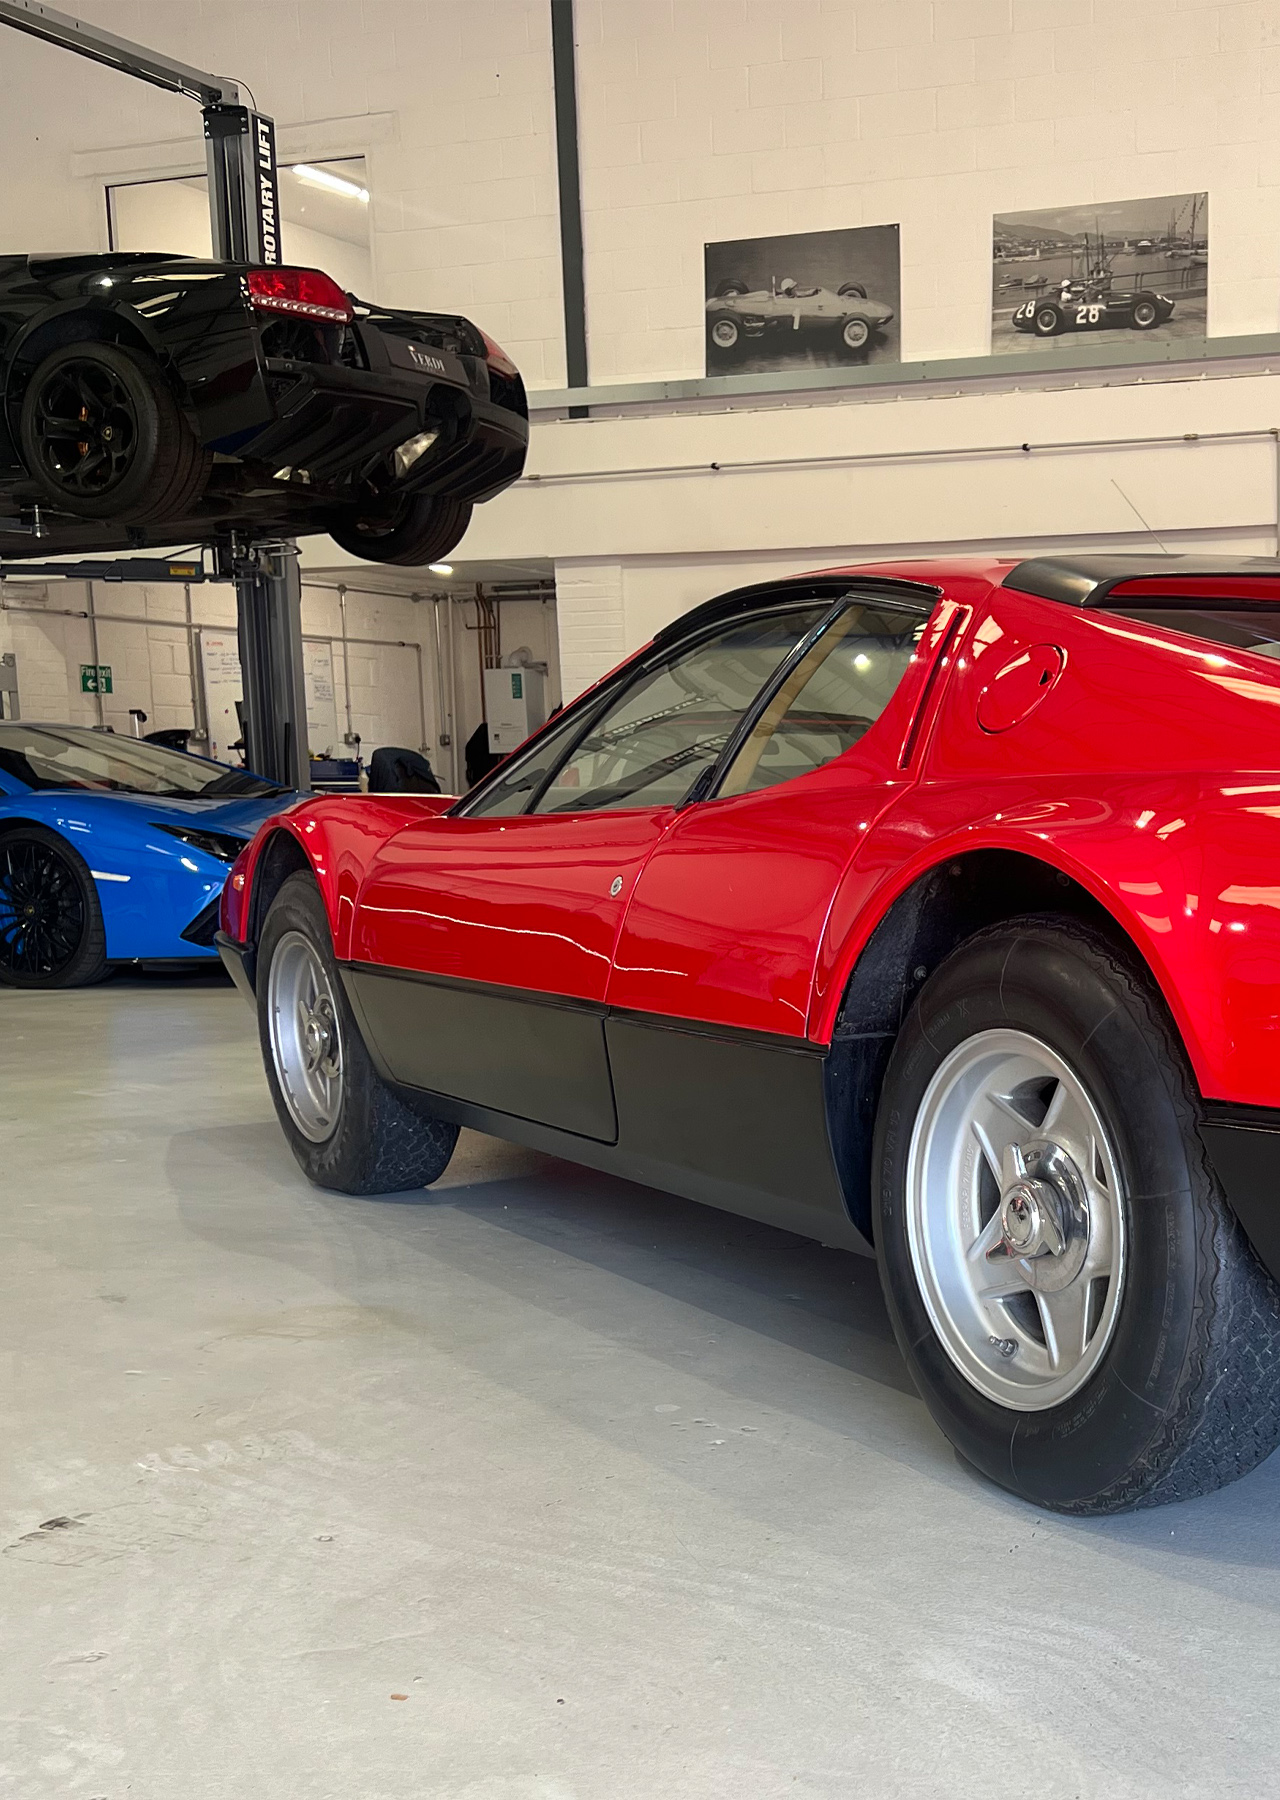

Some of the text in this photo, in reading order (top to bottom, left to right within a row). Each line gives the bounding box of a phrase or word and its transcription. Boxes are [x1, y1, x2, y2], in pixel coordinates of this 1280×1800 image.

[257, 118, 277, 265] ROTARY LIFT
[1016, 301, 1036, 319] 28
[1075, 305, 1100, 324] 28
[409, 350, 446, 372] VERDI
[81, 666, 96, 677] Fire
